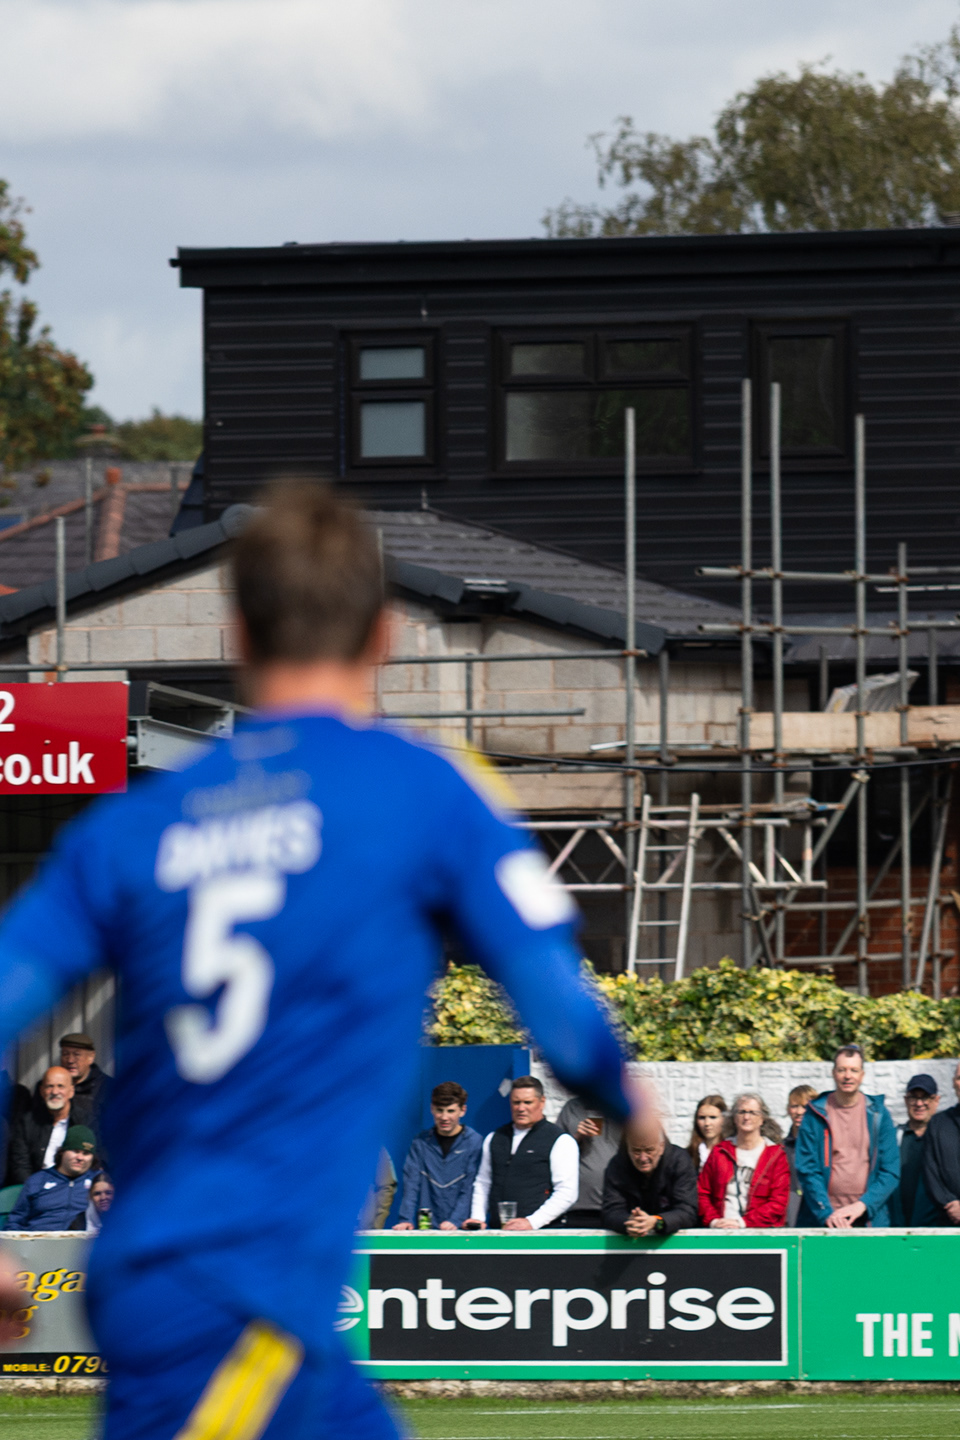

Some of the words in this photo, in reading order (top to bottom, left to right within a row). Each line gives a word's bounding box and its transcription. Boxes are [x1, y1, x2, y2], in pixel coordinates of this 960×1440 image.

[0, 741, 96, 786] o.uk
[164, 874, 286, 1085] 5
[855, 1312, 935, 1358] THE
